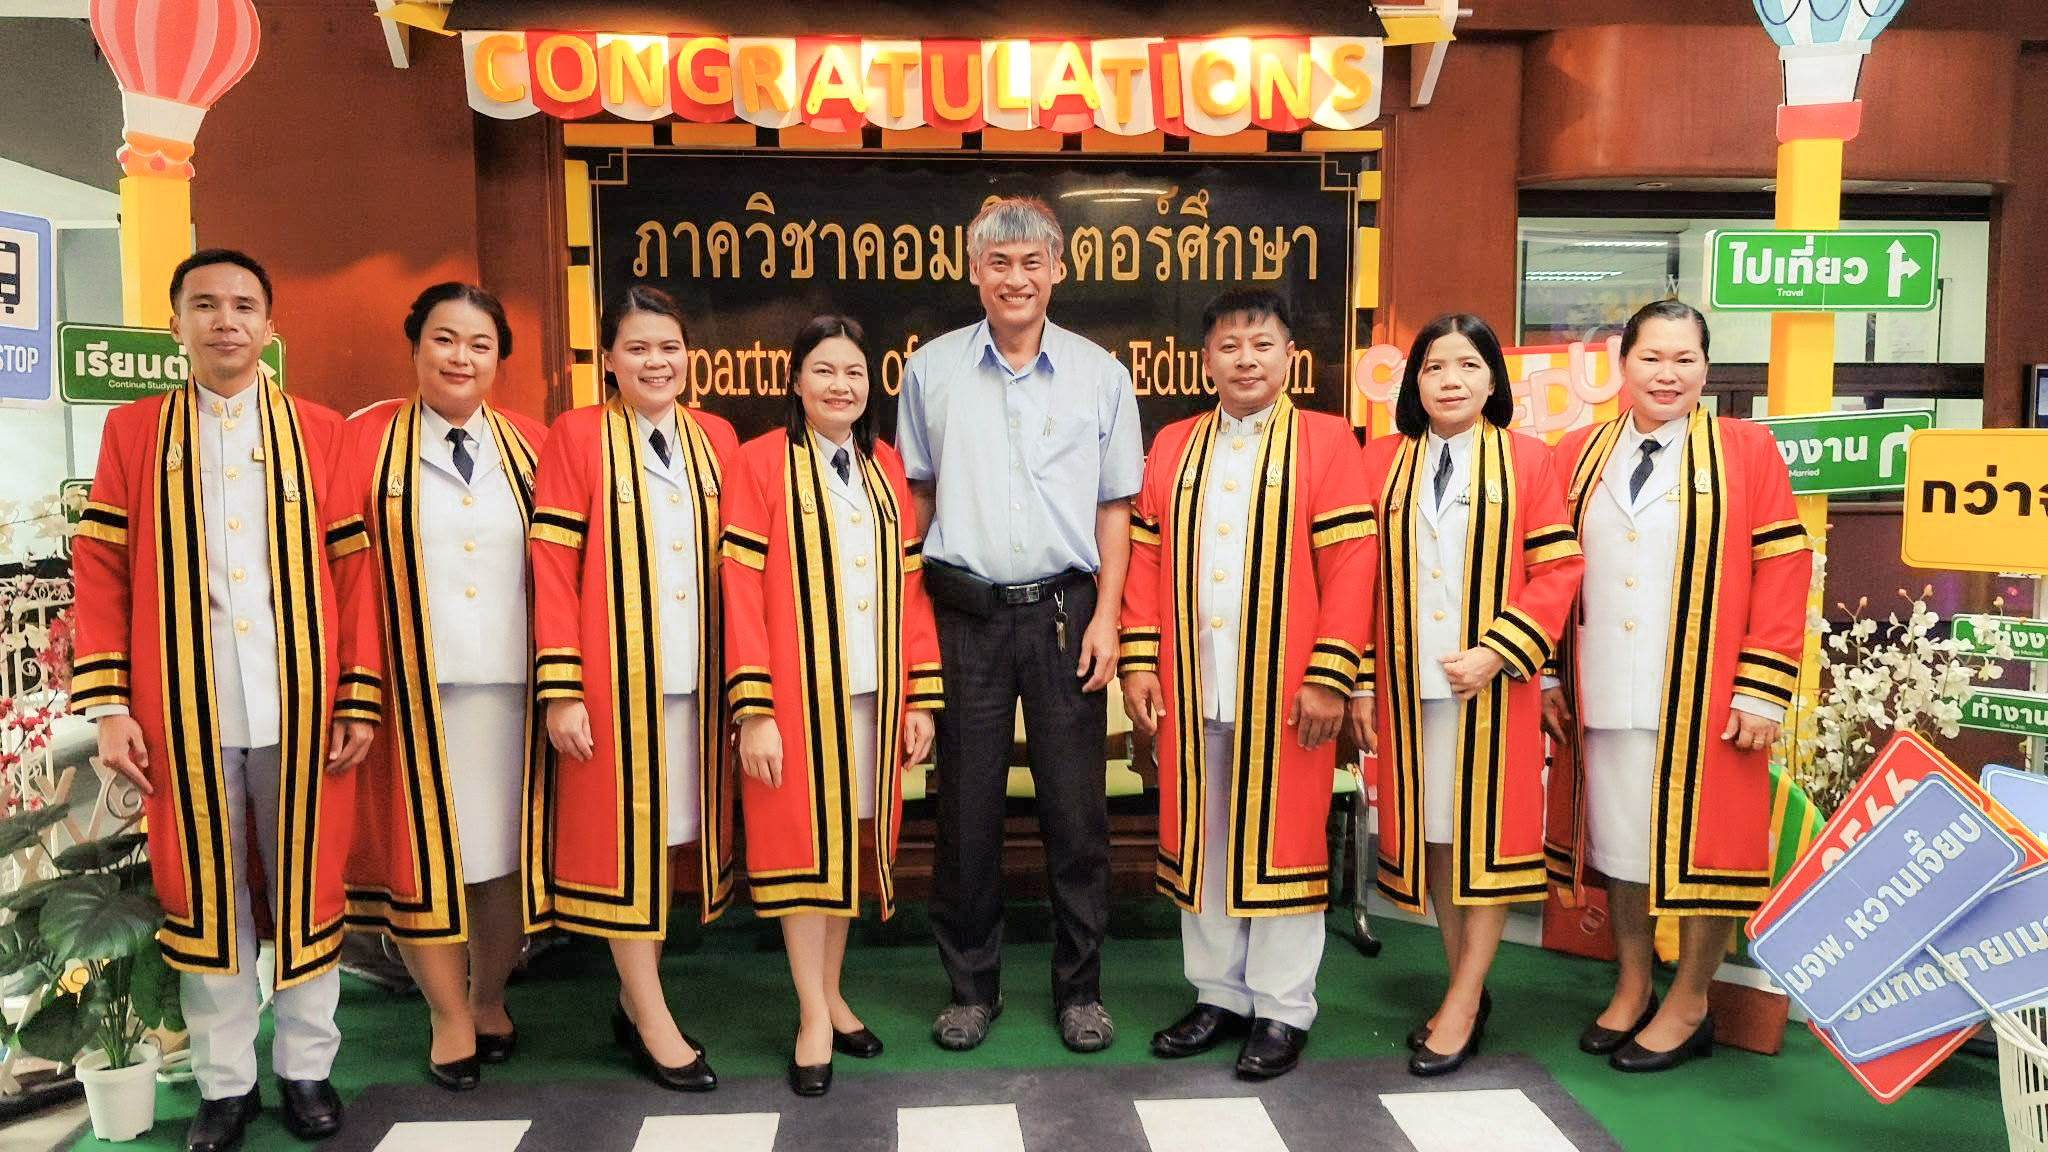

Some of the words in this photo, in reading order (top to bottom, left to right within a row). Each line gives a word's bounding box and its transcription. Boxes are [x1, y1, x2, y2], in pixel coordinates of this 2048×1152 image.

[474, 34, 1373, 125] CONGRATULATIONS
[1729, 236, 1869, 285] ไปเที่ยว
[1776, 288, 1804, 297] Travel
[75, 341, 189, 381] เรียนต่
[108, 379, 146, 390] Continue
[1788, 468, 1820, 478] Married
[1971, 697, 2048, 726] ทำงาน
[1784, 934, 1854, 994] มจพ.
[1844, 812, 1982, 940] หวานเจี๊ยบ
